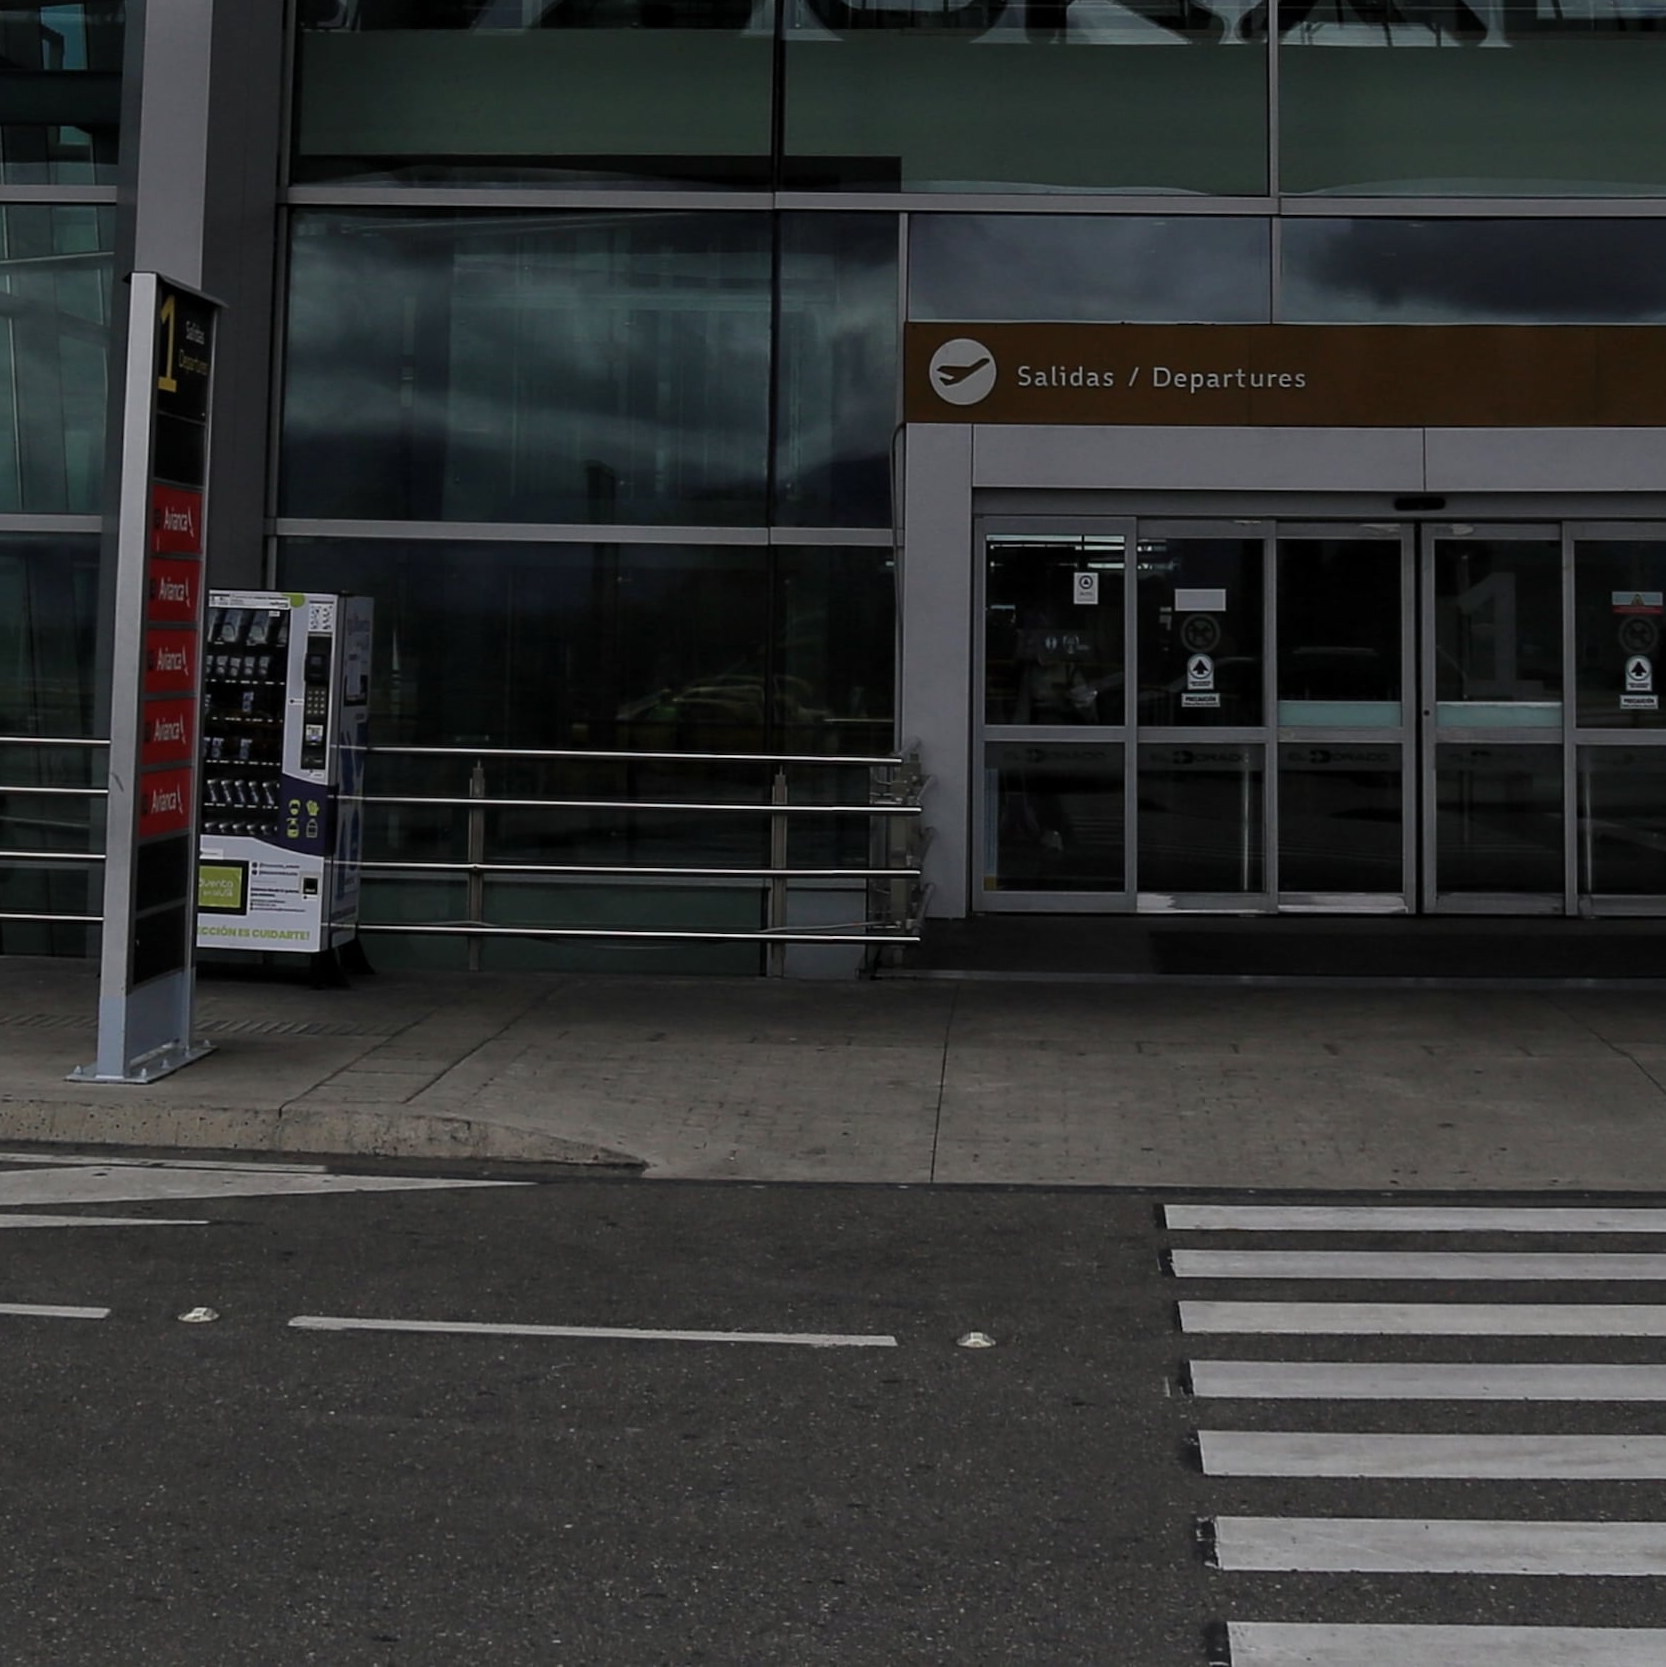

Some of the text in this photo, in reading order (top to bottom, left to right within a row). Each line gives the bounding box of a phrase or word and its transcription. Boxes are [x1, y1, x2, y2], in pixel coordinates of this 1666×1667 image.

[158, 293, 178, 393] 1
[1017, 365, 1114, 387] Salidas
[1128, 365, 1140, 388] /
[1152, 366, 1307, 394] Departures
[1172, 749, 1249, 764] DORAD
[252, 928, 310, 941] CUIDARTE!
